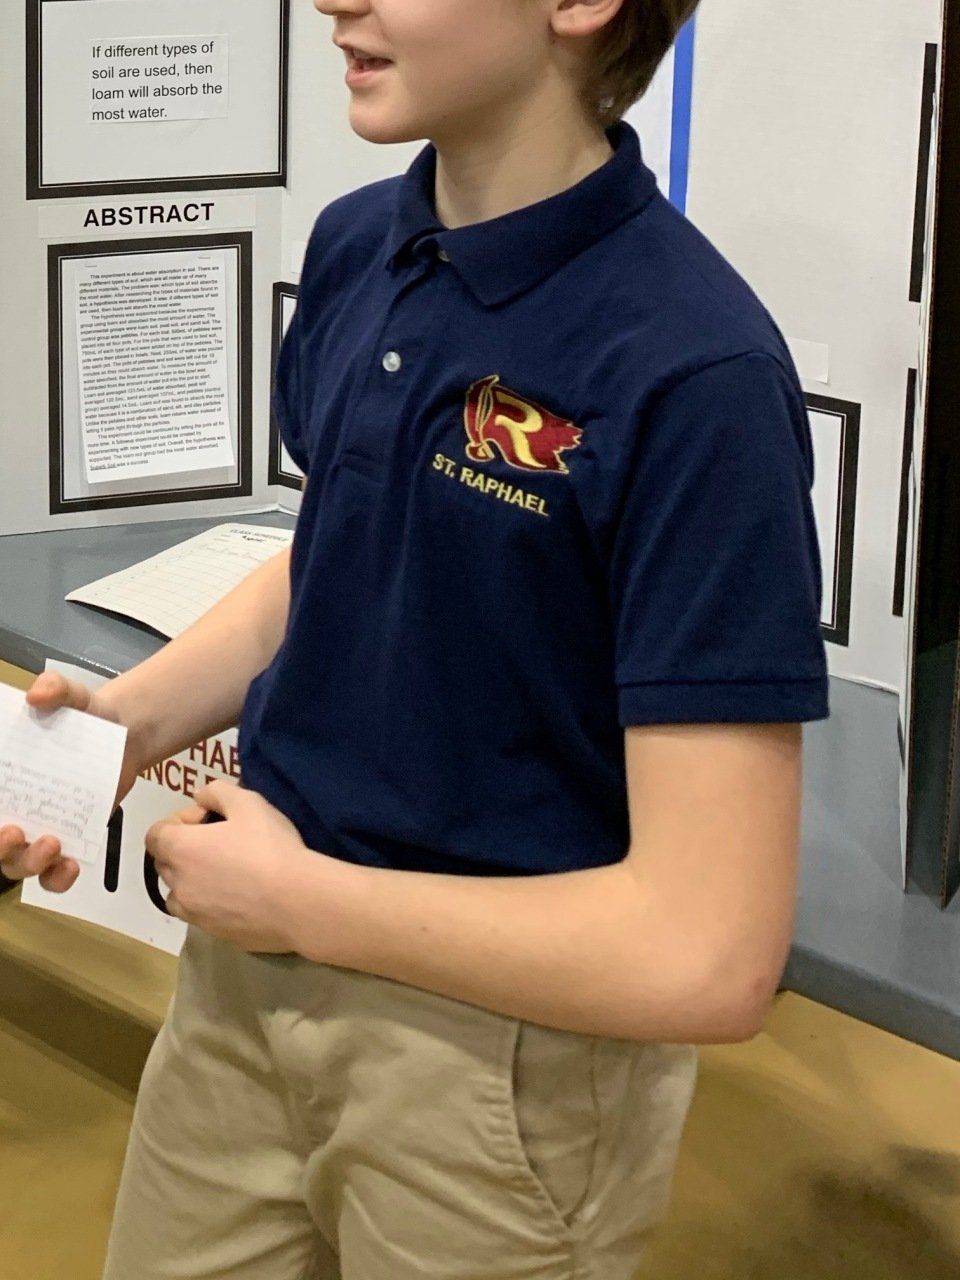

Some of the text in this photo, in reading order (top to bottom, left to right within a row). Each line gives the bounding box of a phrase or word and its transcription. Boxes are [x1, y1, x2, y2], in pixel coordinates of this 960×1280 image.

[91, 41, 214, 60] If different types of
[92, 62, 213, 79] soil are used, then
[92, 82, 223, 101] loam will absorb the
[92, 105, 168, 121] most water.
[83, 202, 215, 227] ABSTRACT
[432, 453, 549, 516] ST. RAPHAEL
